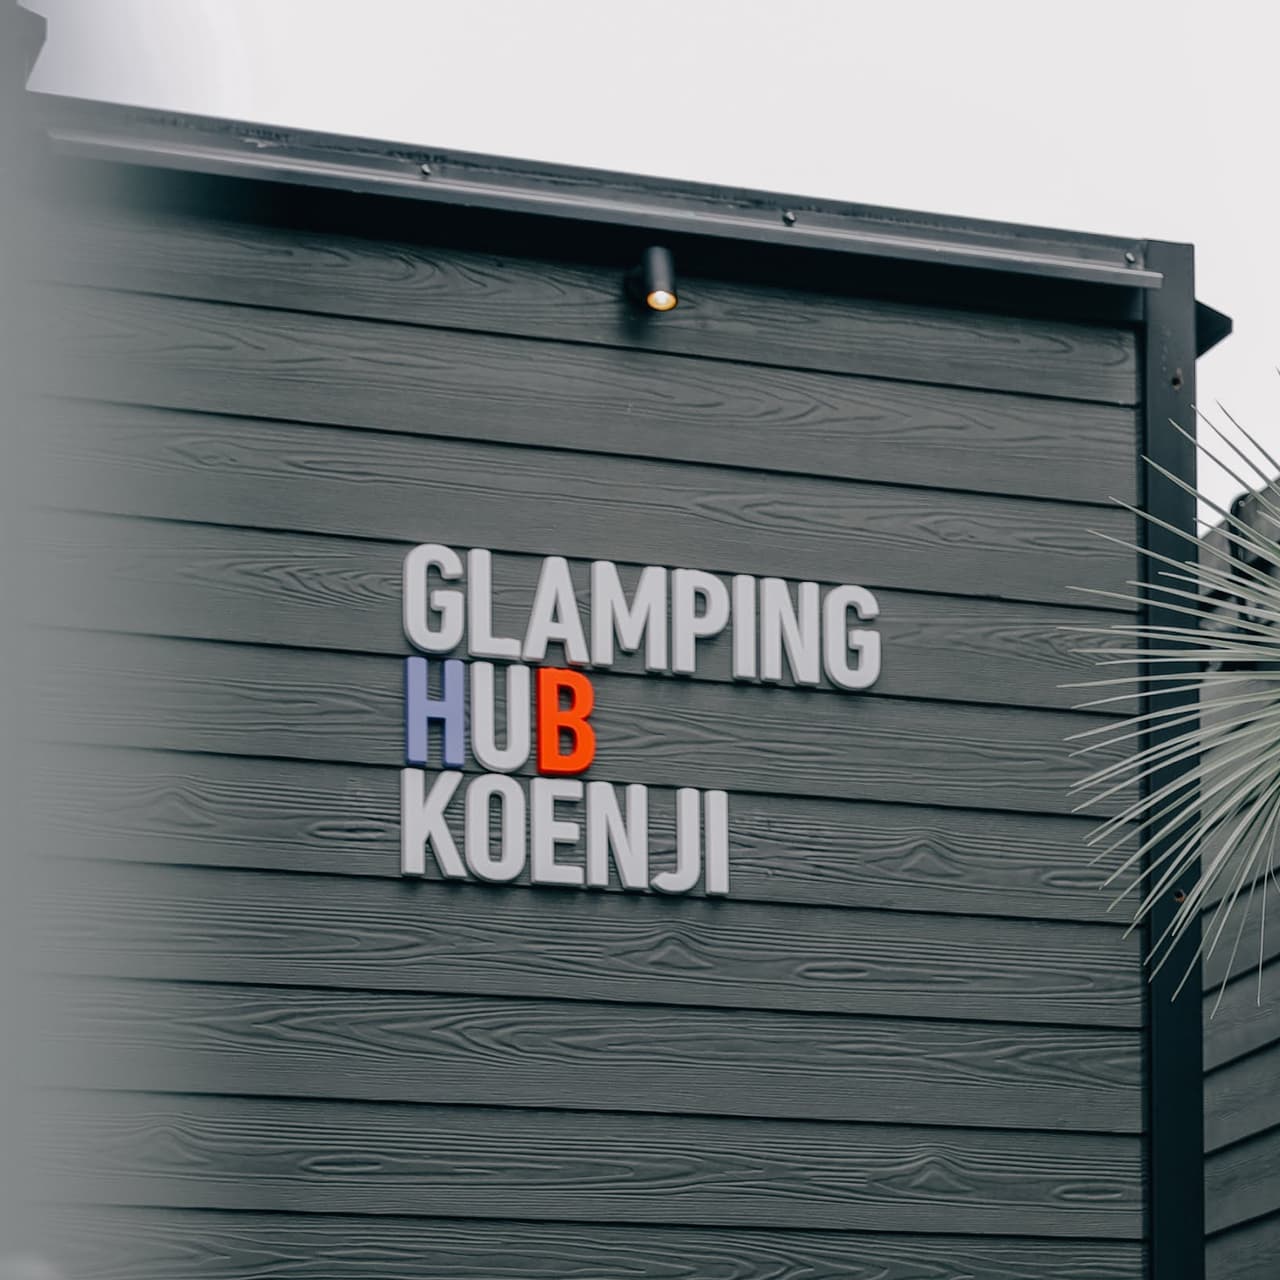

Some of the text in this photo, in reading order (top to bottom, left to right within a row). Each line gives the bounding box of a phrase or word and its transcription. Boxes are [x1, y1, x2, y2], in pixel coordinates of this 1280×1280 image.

[403, 543, 881, 690] GLAMPING
[405, 656, 597, 776] HUB
[400, 768, 729, 895] KOENJI
